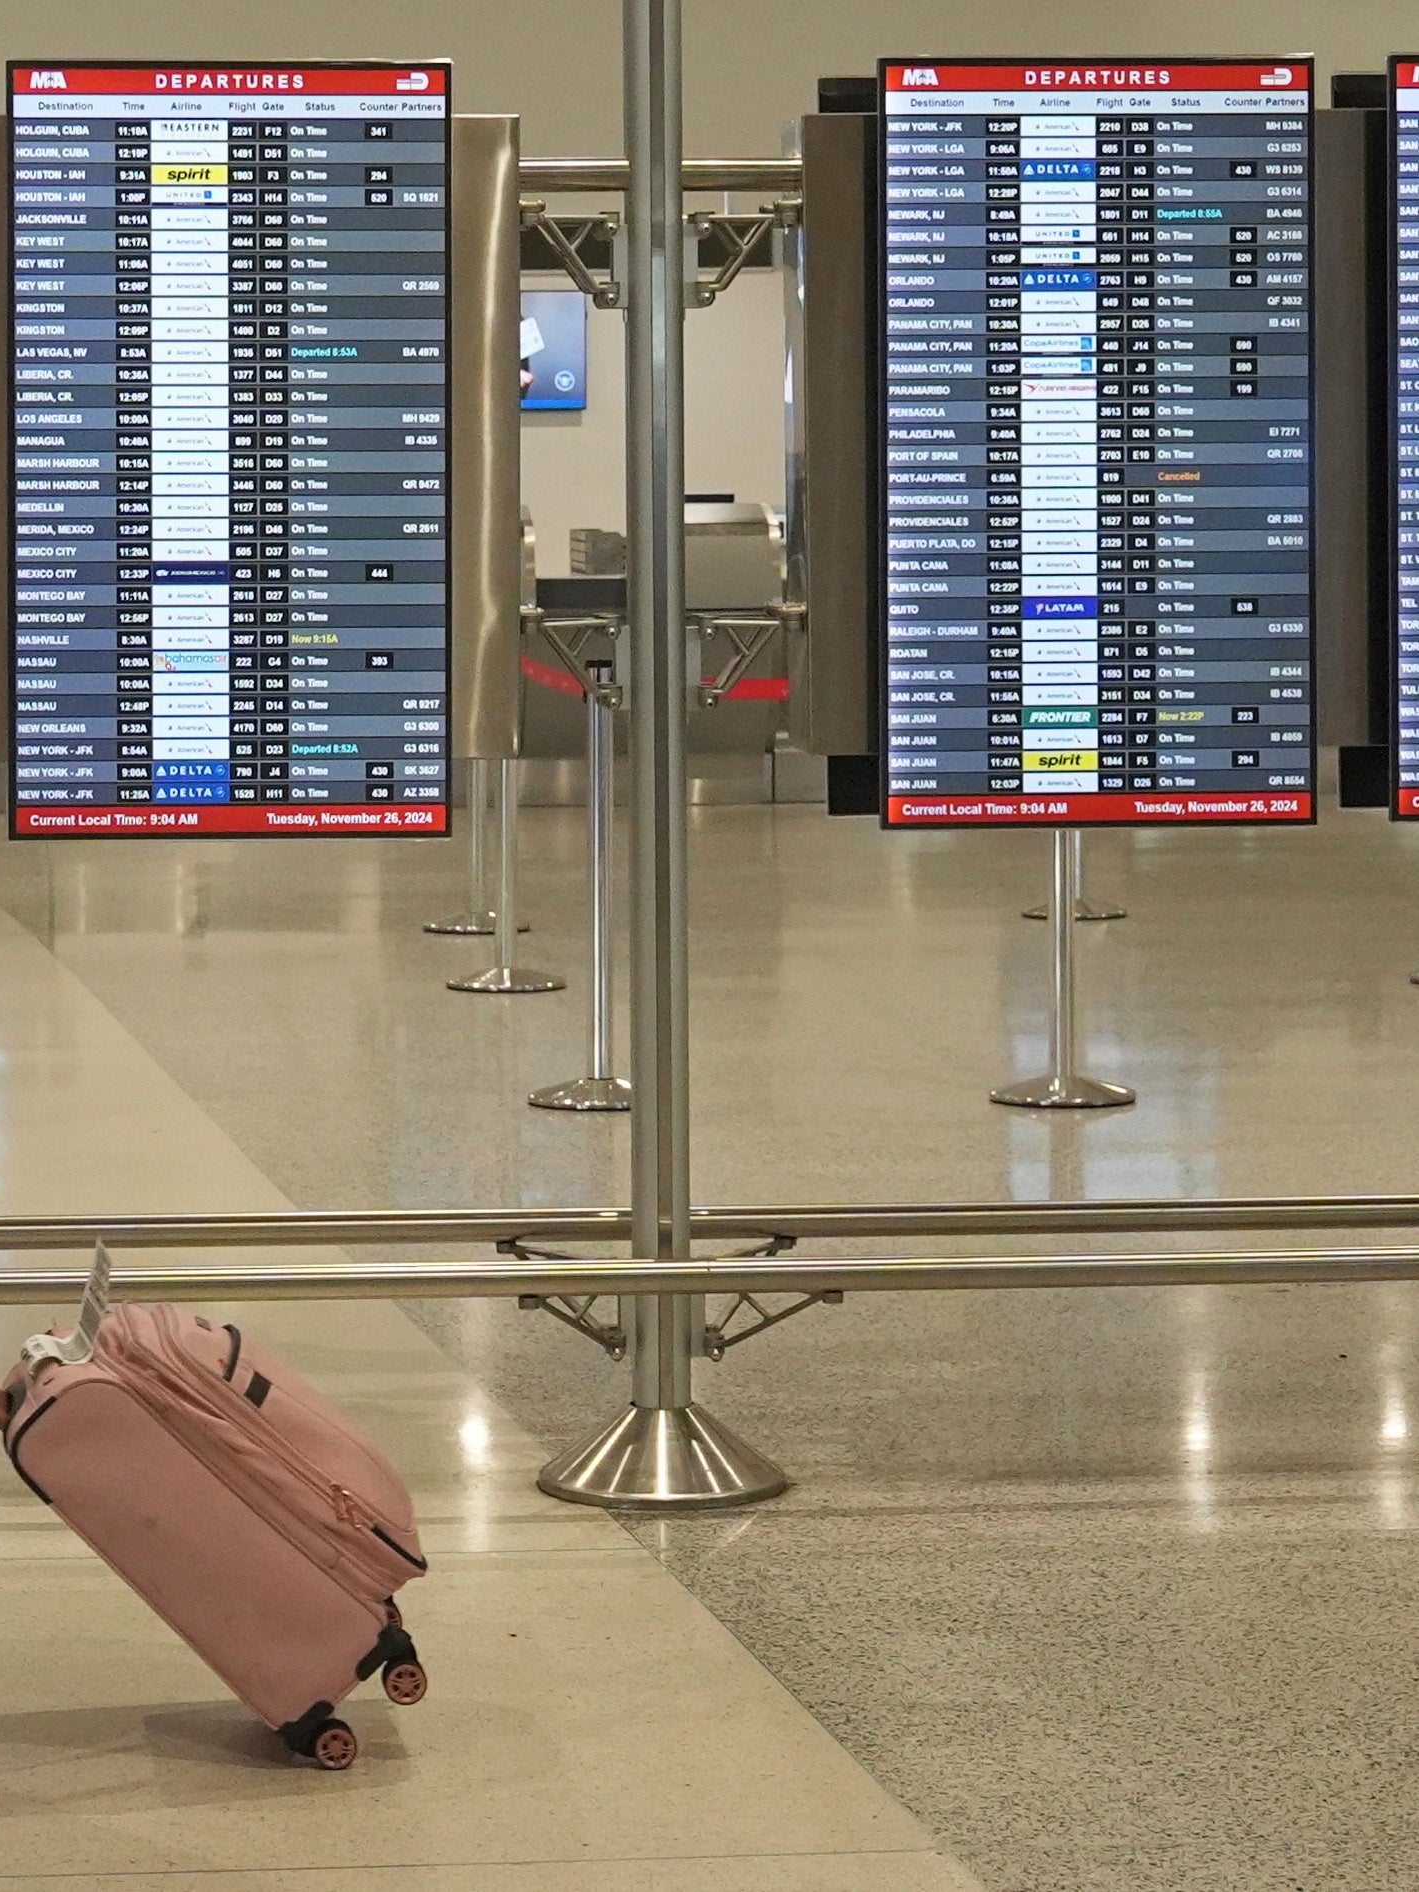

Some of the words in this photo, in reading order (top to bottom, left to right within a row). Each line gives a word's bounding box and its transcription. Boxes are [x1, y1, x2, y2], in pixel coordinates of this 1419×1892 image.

[156, 75, 304, 89] DEPARTURES
[1025, 71, 1170, 85] DEPARTURES
[38, 102, 93, 111] Destination
[123, 102, 145, 111] Time
[171, 102, 202, 111] Airline
[229, 102, 257, 113] Flight
[262, 102, 284, 111] Gate
[305, 102, 335, 111] Status
[359, 102, 398, 111] Counter
[402, 102, 442, 111] Partners
[910, 98, 964, 108] Destination
[993, 98, 1015, 108] Time
[1040, 98, 1071, 108] Airline
[1097, 98, 1123, 109] Flight
[1129, 98, 1151, 108] Gate
[1171, 98, 1201, 108] Status
[1224, 98, 1262, 108] Counter
[1265, 98, 1305, 108] Partners
[16, 126, 62, 137] HOLGUIN,
[64, 126, 89, 135] CUBA
[168, 123, 219, 133] EASTERN
[1037, 165, 1078, 174] DELTA
[167, 168, 211, 182] spirit
[16, 215, 87, 225] JACKSONVILLE
[889, 210, 928, 221] NEWARK,
[931, 210, 945, 219] NJ
[17, 237, 35, 246] KEY
[37, 237, 64, 246] WEST
[17, 304, 65, 313] KINGSTON
[17, 348, 37, 357] LAS
[38, 348, 70, 359] VEGAS,
[73, 348, 87, 357] NV
[889, 386, 950, 395] PARAMARIBO
[17, 414, 34, 424] LOS
[37, 414, 82, 424] ANGELES
[890, 429, 955, 439] PHILADELPHIA
[18, 459, 51, 468] MARSH
[53, 459, 100, 468] HARBOUR
[890, 473, 966, 483] PORT-AU-PRINCE
[1158, 472, 1200, 481] Cancelled
[890, 495, 968, 504] PROVIDENCIALES
[18, 525, 56, 536] MERIDA,
[58, 525, 94, 534] MEXICO
[890, 561, 920, 570] PUNTA
[922, 561, 948, 570] CANA
[18, 591, 61, 601] MONTEGO
[64, 591, 85, 601] BAY
[1401, 598, 1417, 607] TEL
[890, 605, 919, 615] QUITO
[18, 635, 69, 645] NASHVILLE
[18, 657, 56, 667] NASSAU
[165, 653, 227, 665] bahamasair
[891, 714, 908, 724] SAN
[910, 714, 936, 724] JUAN
[18, 723, 39, 733] NEW
[42, 723, 86, 733] ORLEANS
[292, 744, 330, 754] Departed
[1038, 754, 1082, 767] spirit
[170, 789, 212, 797] DELTA
[903, 803, 947, 815] Current
[949, 803, 982, 815] Local
[985, 803, 1018, 815] Time:
[1020, 803, 1046, 815] 9:04
[1048, 803, 1067, 815] AM
[1135, 802, 1185, 815] Tuesday,
[1188, 802, 1248, 813] November
[1250, 802, 1268, 815] 26,
[1271, 802, 1298, 813] 2024
[30, 814, 75, 826] Current
[78, 814, 111, 826] Local
[114, 814, 147, 826] Time:
[150, 814, 176, 826] 9:04
[178, 814, 198, 826] AM
[267, 813, 321, 826] Tuesday,
[321, 813, 382, 824] November
[384, 813, 401, 826] 26,
[405, 813, 432, 824] 2024
